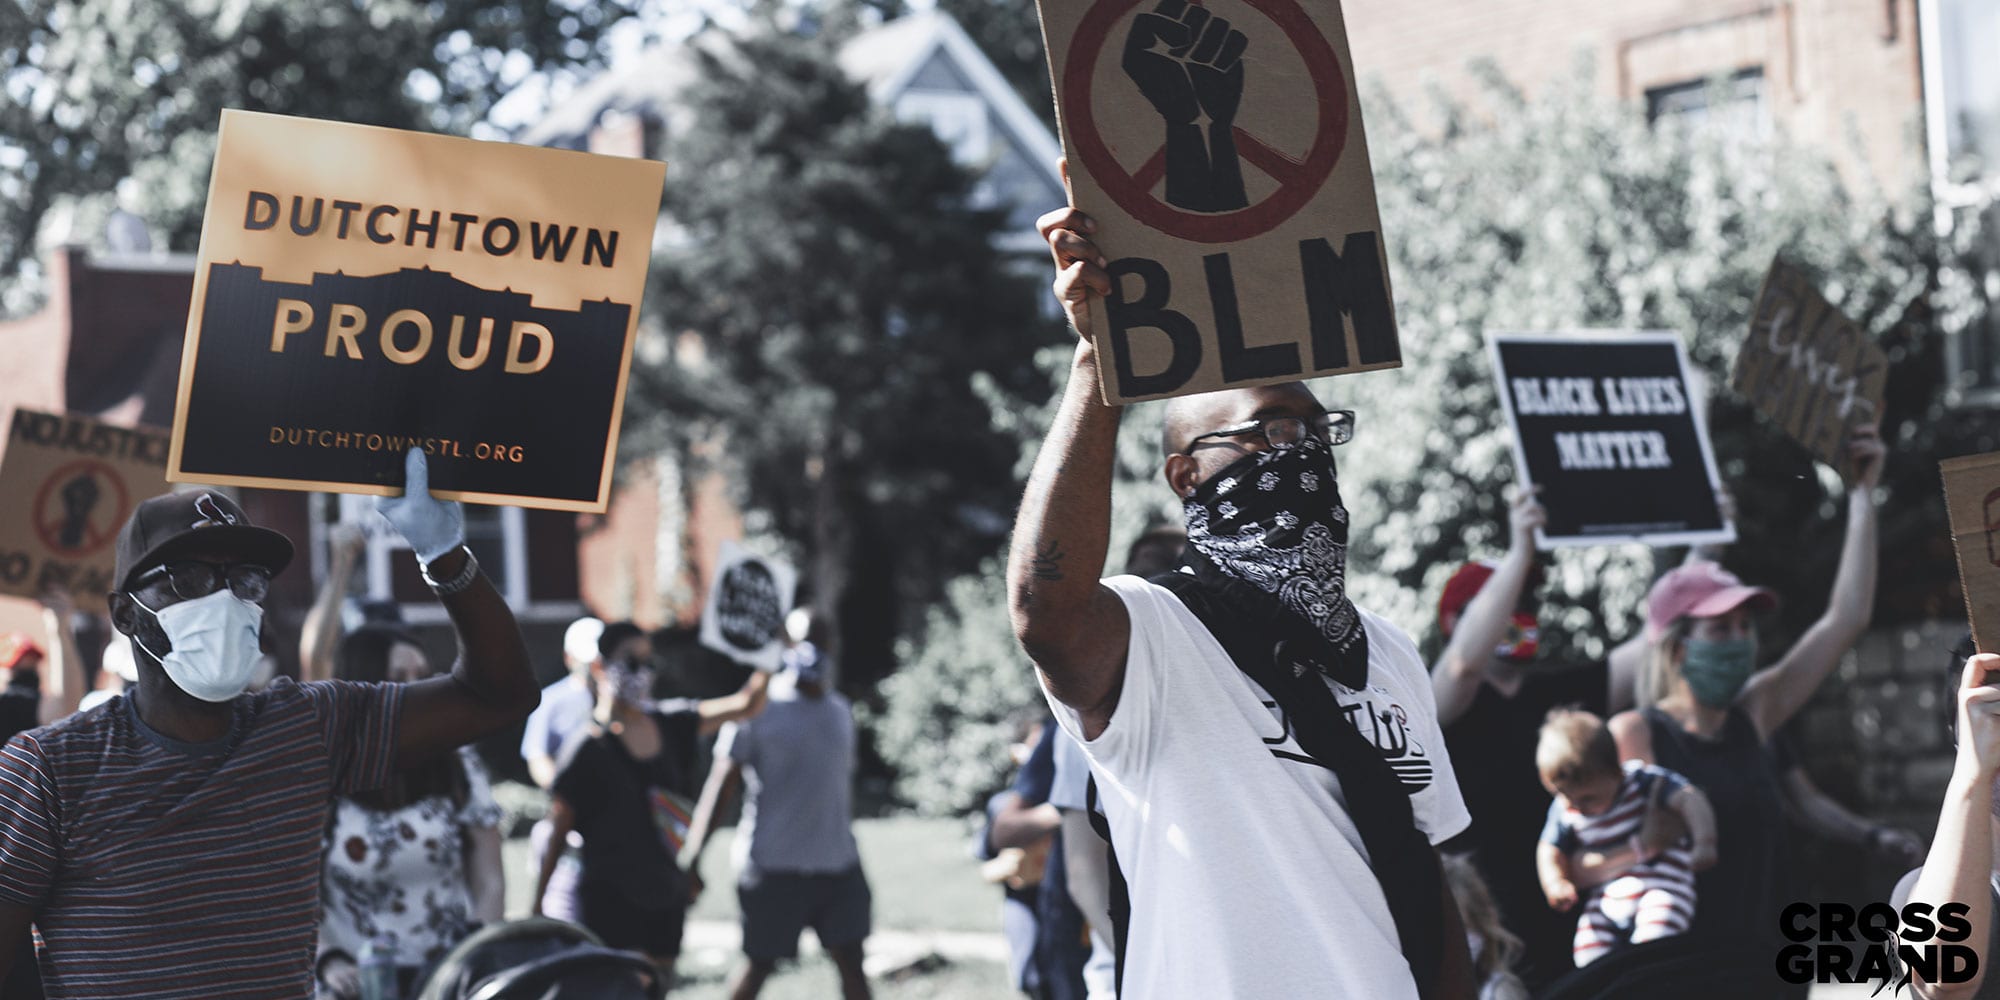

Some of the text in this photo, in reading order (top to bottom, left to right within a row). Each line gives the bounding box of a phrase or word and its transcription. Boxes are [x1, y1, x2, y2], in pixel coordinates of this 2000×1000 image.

[244, 190, 619, 268] DUTCHTOWN
[271, 299, 555, 374] PROUD
[1103, 231, 1402, 398] BLM
[1512, 377, 1686, 415] BLACK LIVES
[1555, 431, 1672, 469] MATTER
